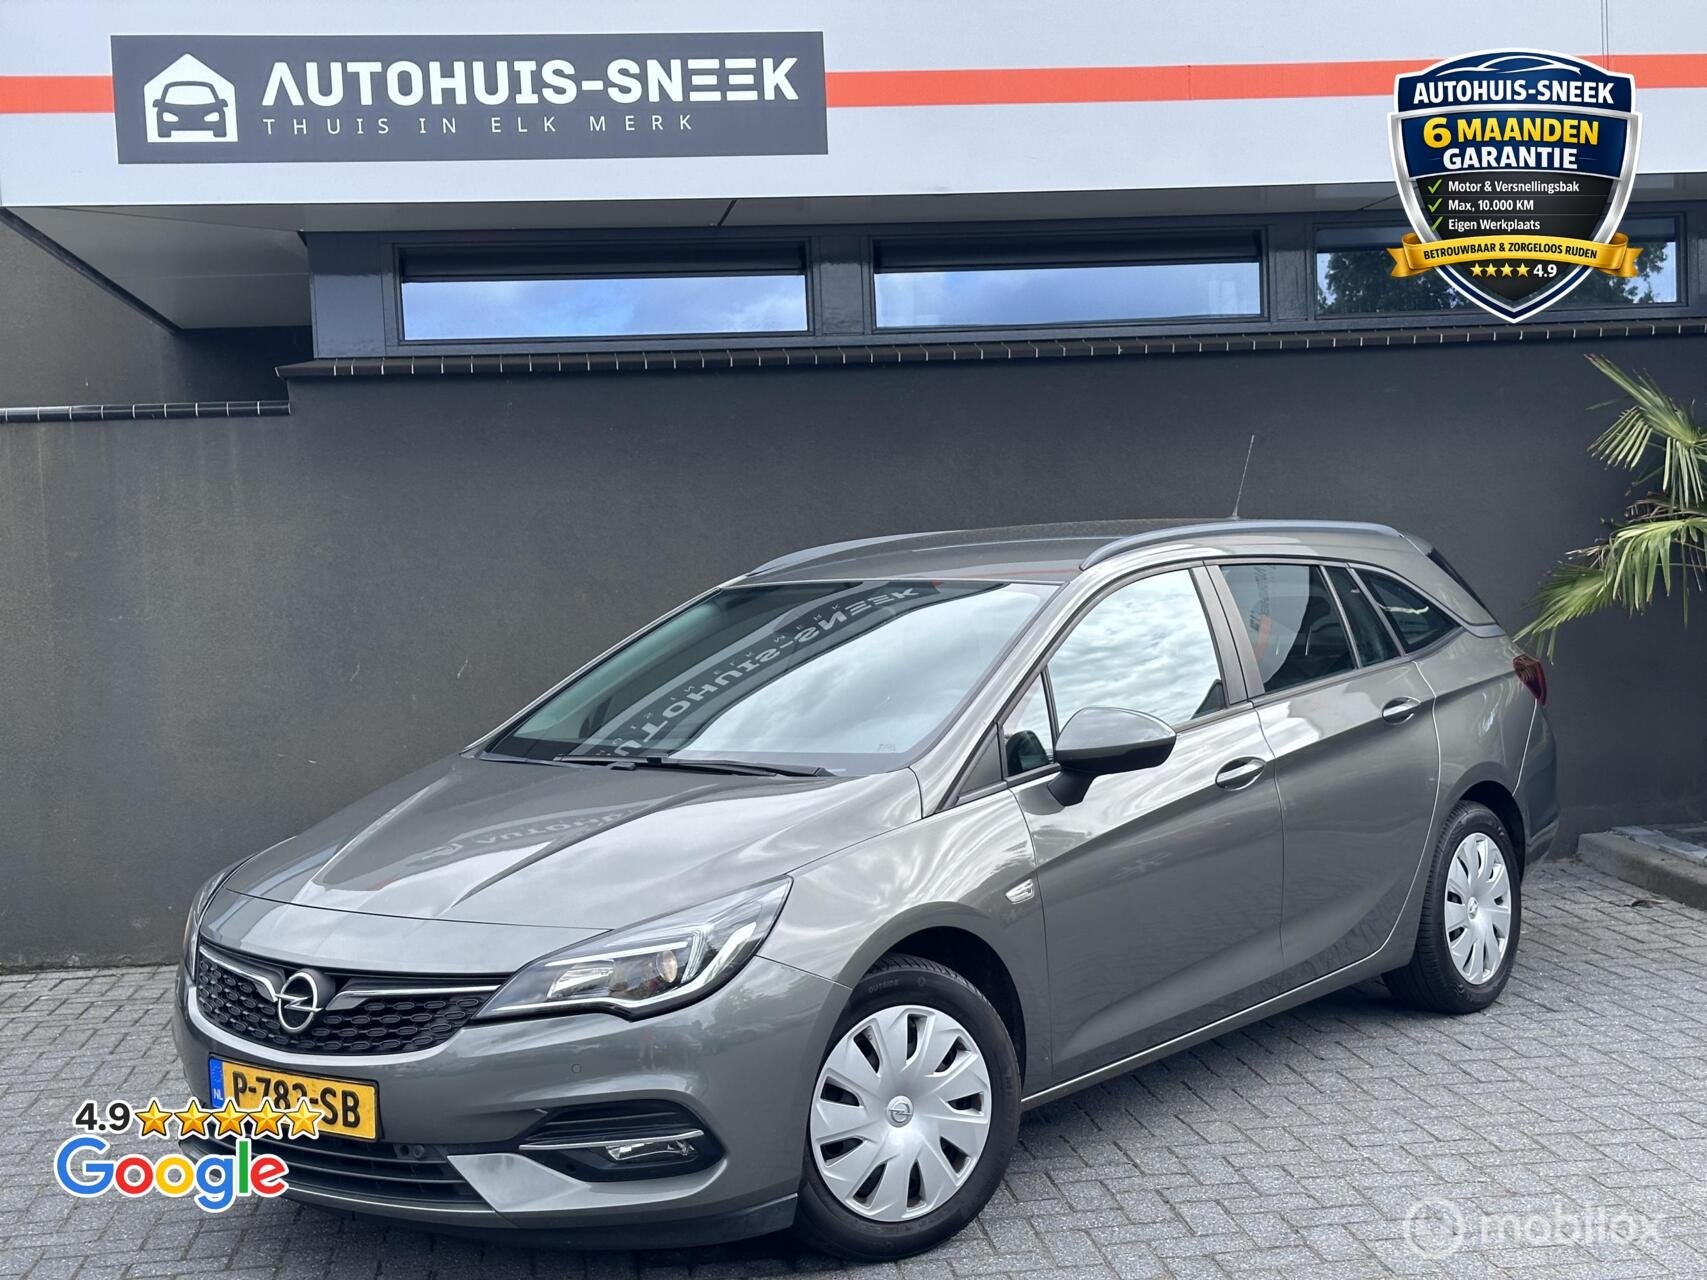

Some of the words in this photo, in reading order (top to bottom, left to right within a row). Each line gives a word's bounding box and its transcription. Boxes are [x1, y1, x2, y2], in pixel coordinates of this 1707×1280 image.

[262, 56, 799, 108] AUTOHUIS-SNEEK
[263, 117, 390, 136] THUIS
[419, 116, 457, 134] IN
[491, 115, 557, 134] ELK
[589, 114, 694, 132] MERK
[213, 1087, 223, 1101] NL
